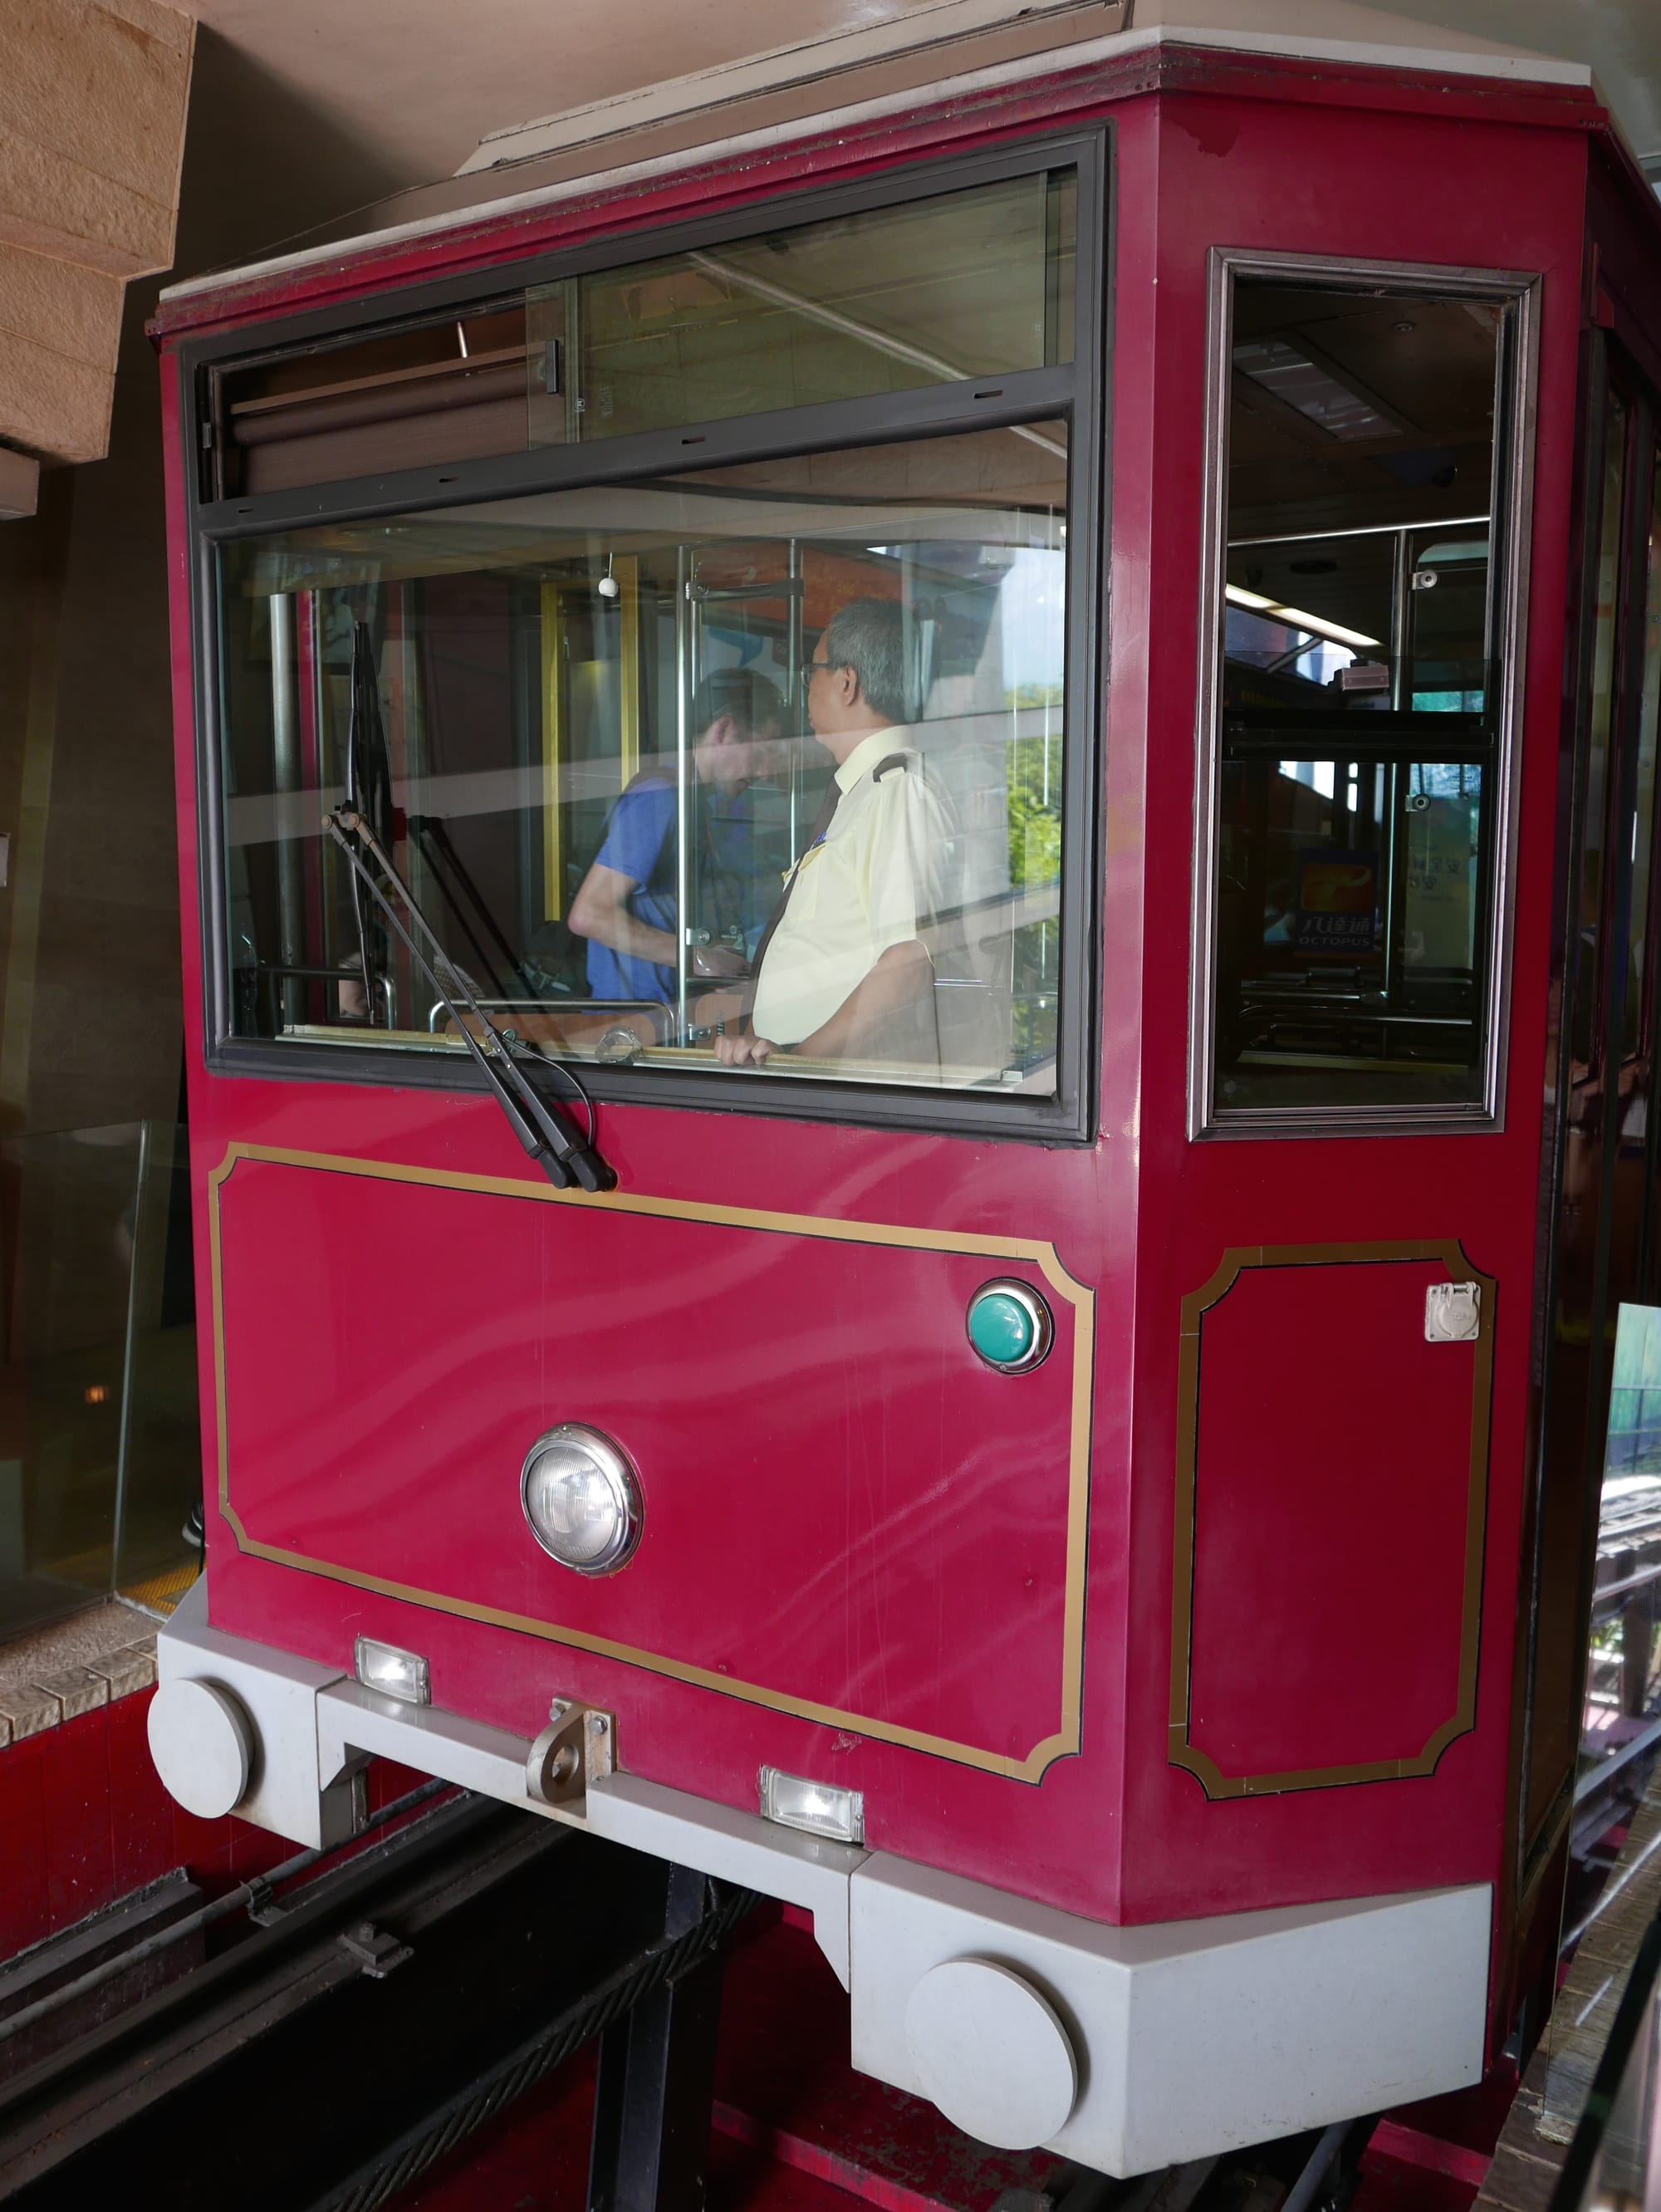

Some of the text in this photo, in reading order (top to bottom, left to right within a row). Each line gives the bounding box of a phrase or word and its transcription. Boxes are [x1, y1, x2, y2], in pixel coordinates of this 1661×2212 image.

[1301, 916, 1370, 935] 八達通
[1298, 936, 1370, 946] OCTOPUS
